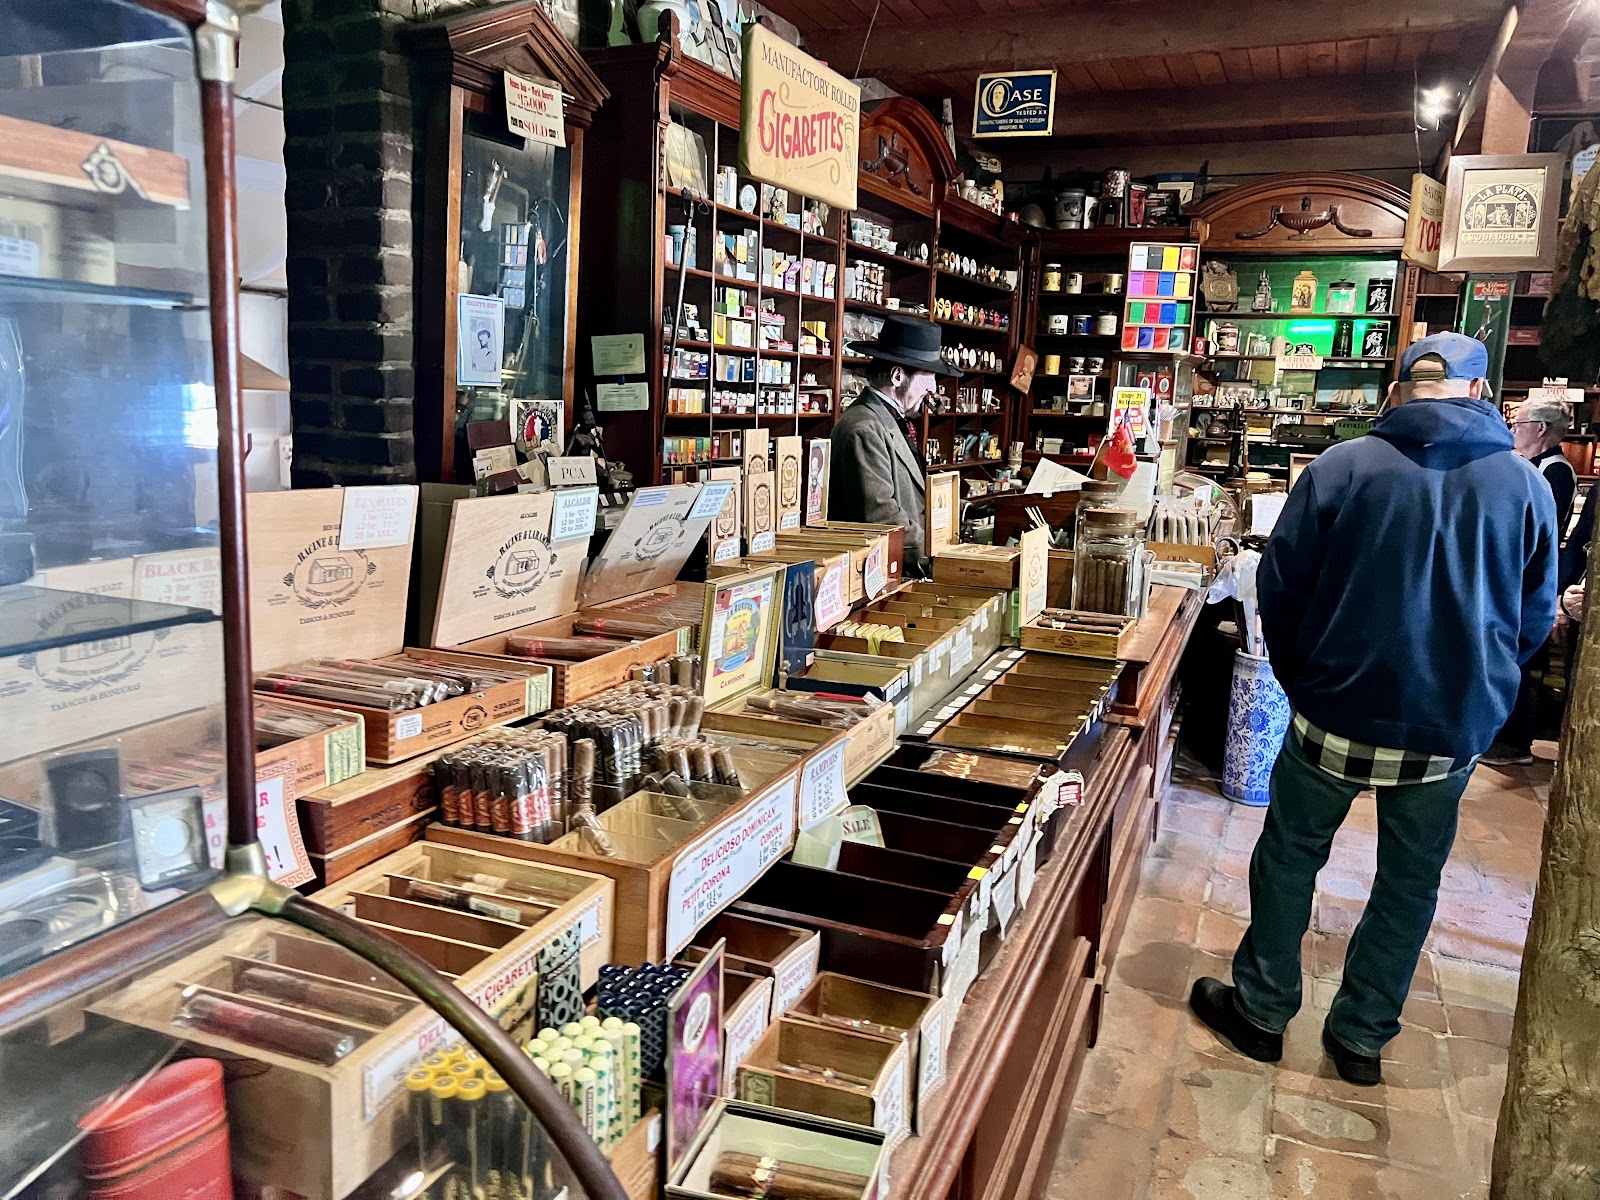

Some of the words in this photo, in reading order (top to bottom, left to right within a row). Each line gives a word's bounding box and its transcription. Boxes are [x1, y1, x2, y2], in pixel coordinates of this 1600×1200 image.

[762, 42, 830, 98] MANUFACTORY
[831, 84, 857, 113] ROLLED
[981, 78, 1045, 117] CASE
[757, 88, 843, 160] CIGARETTES
[1477, 189, 1494, 201] LA
[1495, 185, 1526, 200] PLATA
[561, 467, 585, 480] PCA
[145, 561, 200, 578] BLACK
[701, 835, 740, 871] DELICIOSO
[741, 805, 777, 842] DOMINICAN
[761, 822, 783, 847] CORONA
[842, 819, 872, 836] SALE
[682, 887, 701, 913] PETIT
[701, 865, 731, 894] CORONA
[485, 955, 537, 1001] CIGARETT
